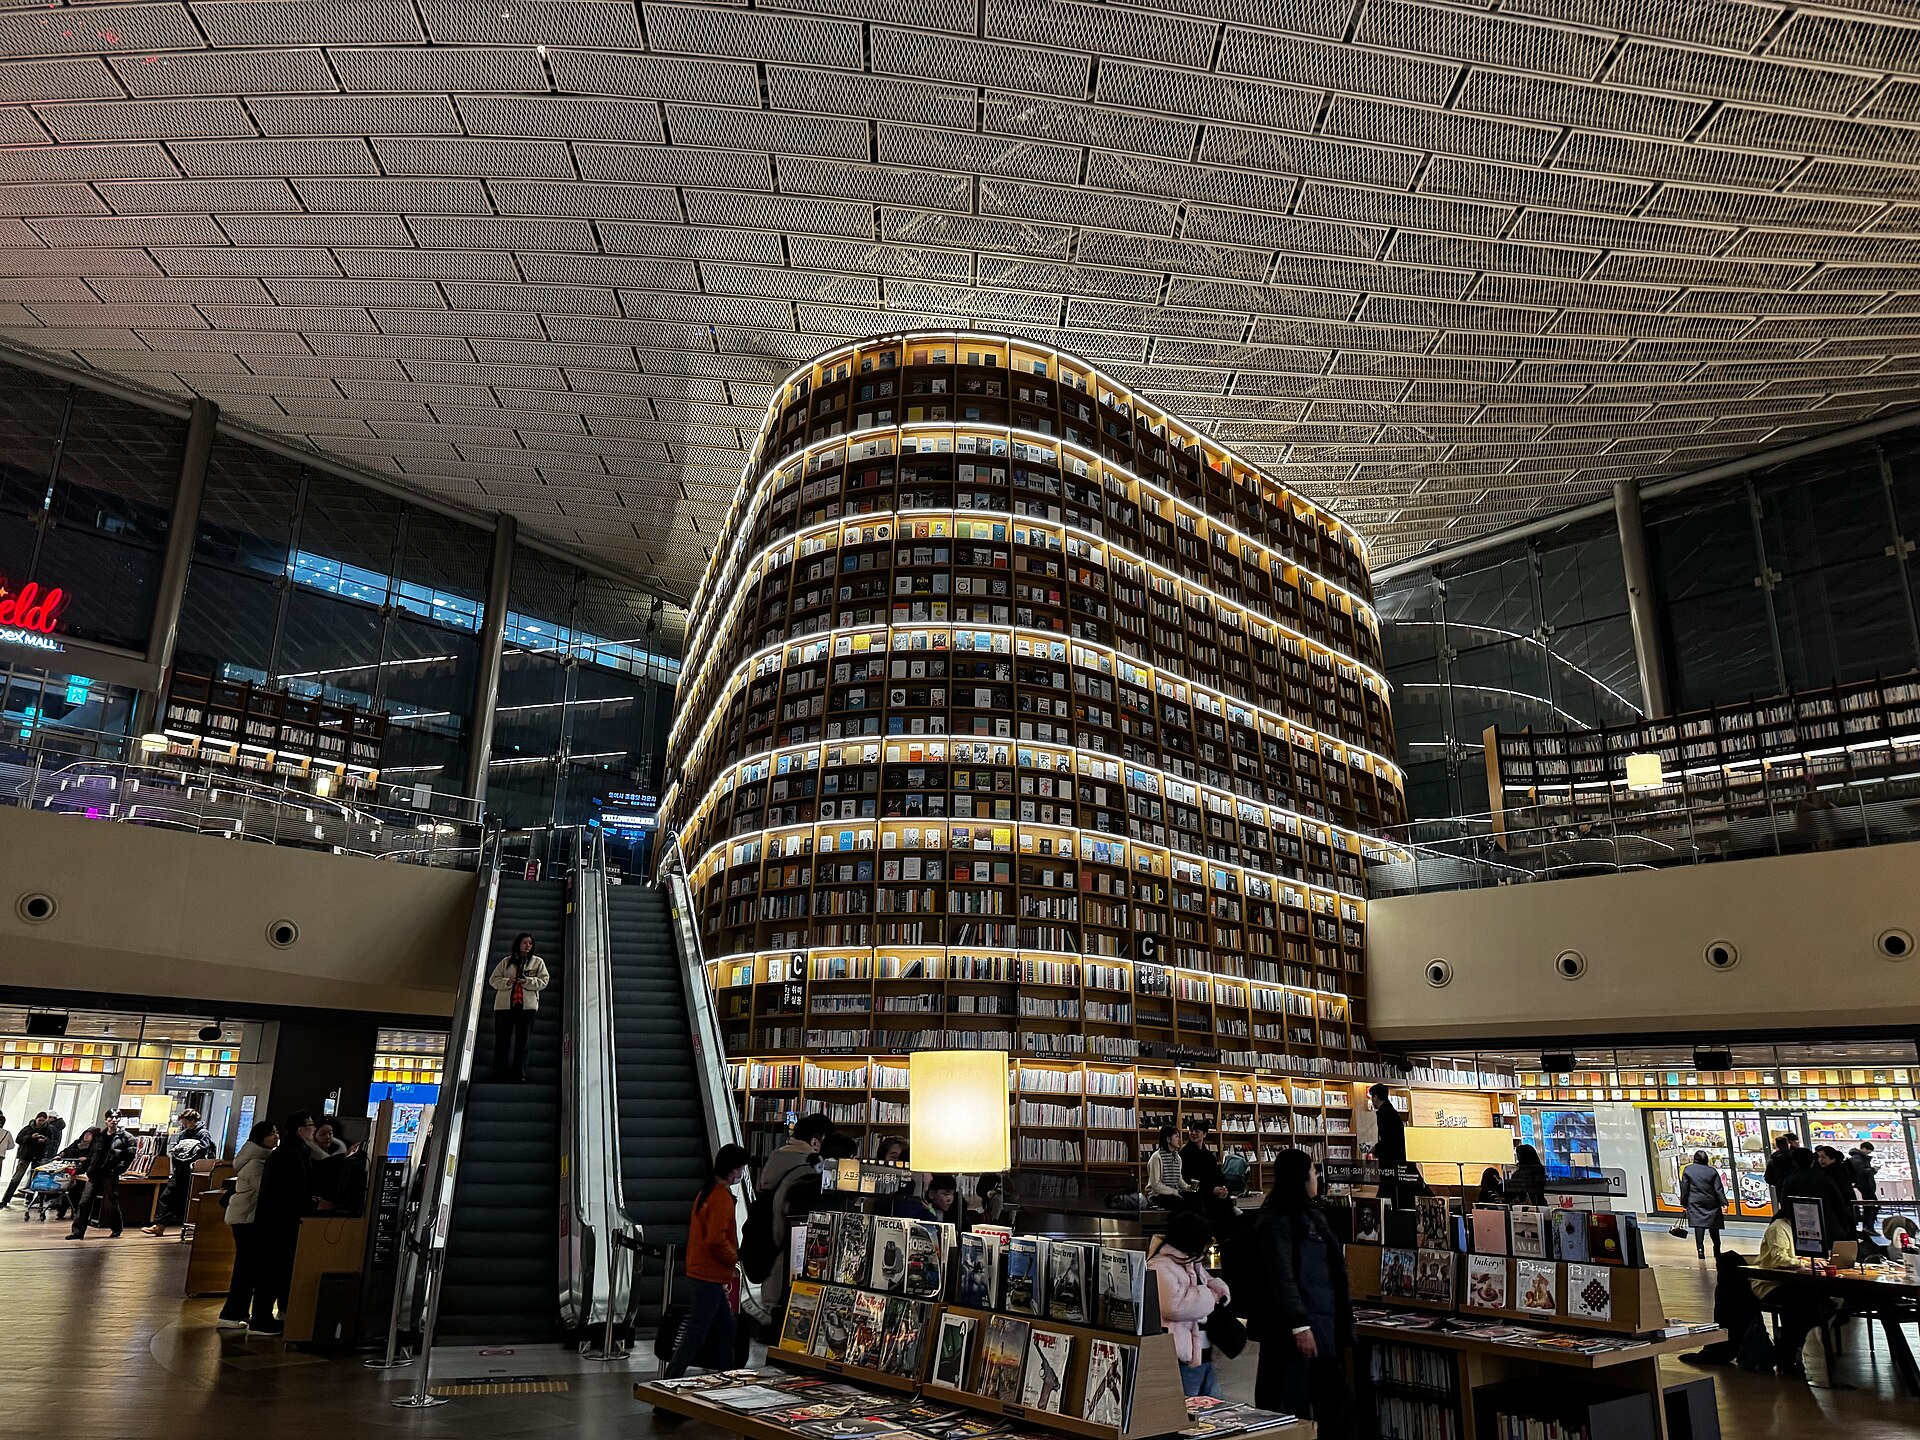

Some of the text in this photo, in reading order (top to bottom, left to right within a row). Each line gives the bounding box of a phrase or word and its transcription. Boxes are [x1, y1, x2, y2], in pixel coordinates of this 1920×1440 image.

[1142, 937, 1154, 956] C
[793, 955, 803, 976] C
[1327, 1165, 1338, 1175] D4
